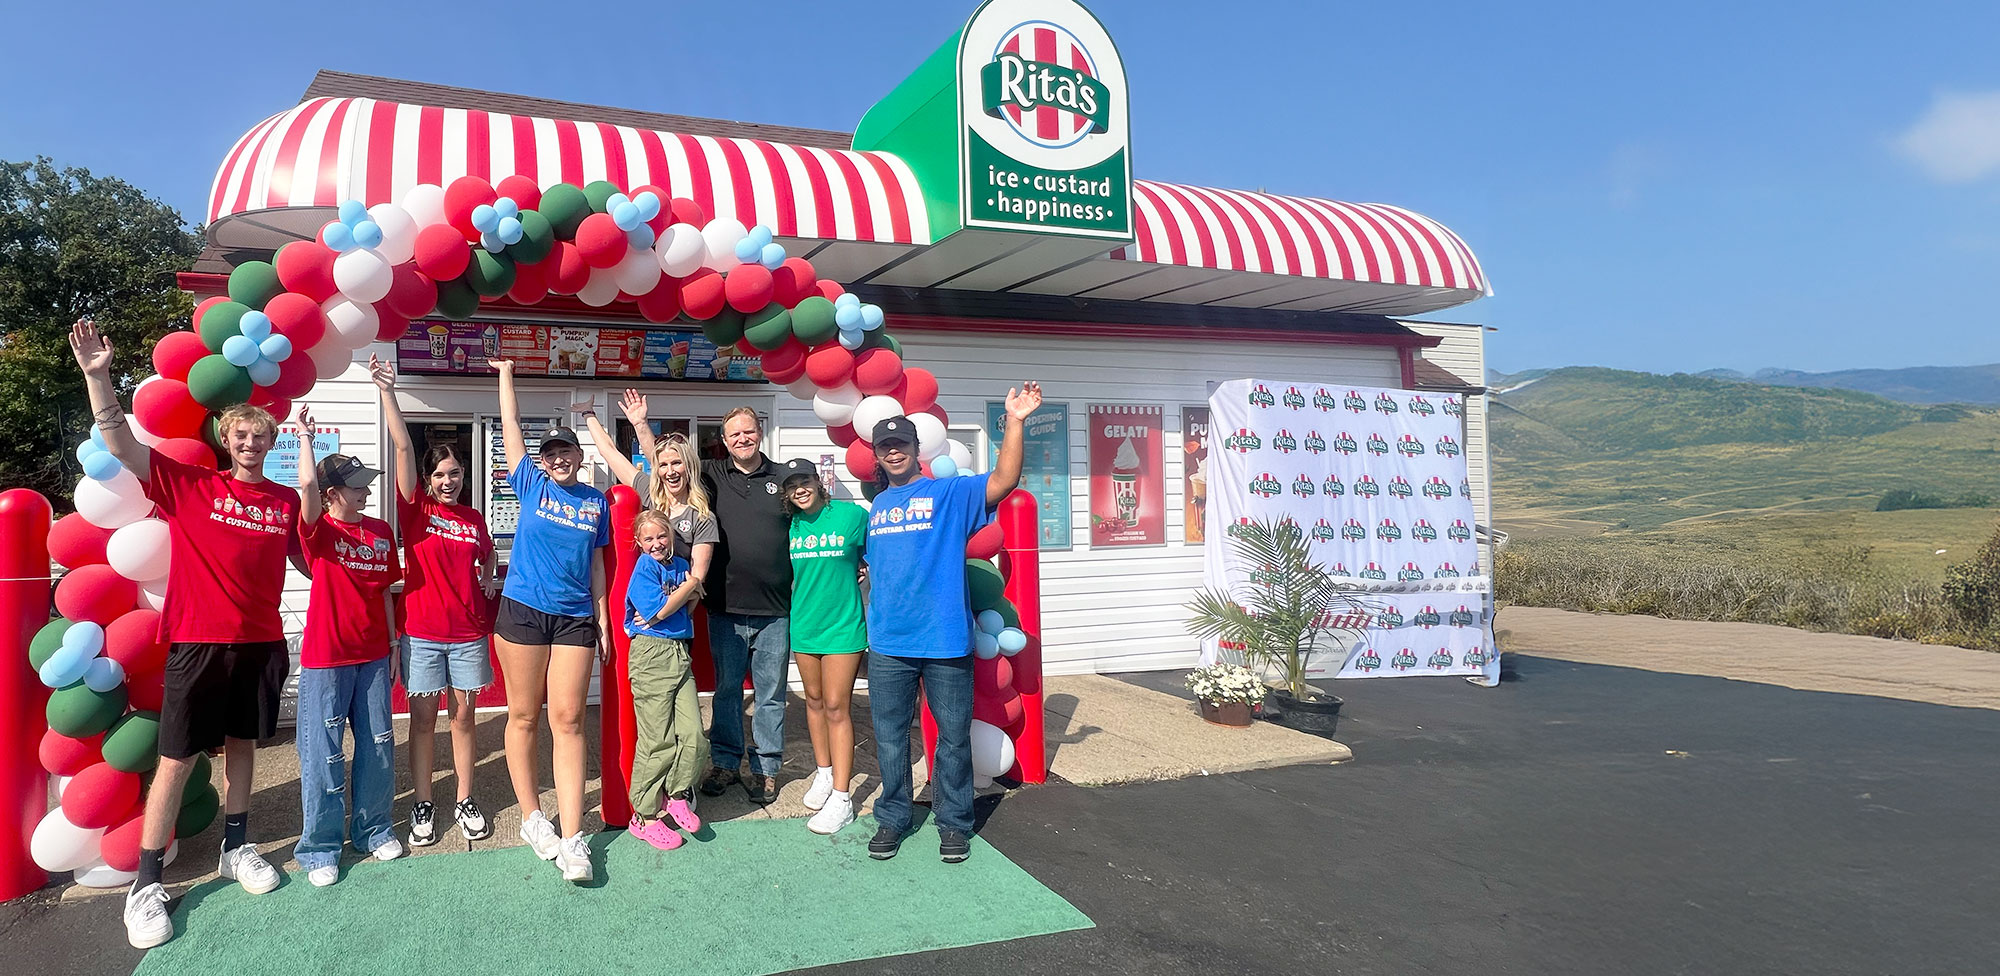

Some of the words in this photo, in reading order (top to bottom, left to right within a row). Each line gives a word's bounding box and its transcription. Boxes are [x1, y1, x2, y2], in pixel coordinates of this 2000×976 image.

[999, 55, 1098, 116] Rita's
[988, 164, 1019, 188] ice
[1033, 174, 1110, 198] custard
[997, 190, 1105, 222] happiness
[502, 328, 532, 336] CUSTARD
[560, 330, 590, 338] PUMPKIN
[1253, 391, 1273, 402] Rita's
[1285, 393, 1303, 404] Rita's
[1315, 395, 1334, 406] Rita's
[1346, 397, 1365, 409] Rita's
[1377, 399, 1397, 410] Rita's
[1411, 402, 1432, 413] Rita's
[1024, 412, 1063, 427] RDERING
[1029, 423, 1057, 437] GUIDE
[1103, 425, 1149, 438] GELATI
[287, 440, 296, 450] OF
[1230, 435, 1259, 447] Rita's
[1275, 437, 1295, 447] Rita's
[1306, 438, 1325, 449] Rita's
[1336, 439, 1356, 450] Rita's
[1368, 440, 1387, 450] Rita's
[1398, 441, 1423, 452] Rita's
[1439, 442, 1458, 452] Rita's
[1253, 480, 1280, 492] Rita's
[1294, 481, 1313, 492] Rita's
[1325, 481, 1344, 492] Rita's
[1357, 481, 1378, 492] Rita's
[1390, 482, 1411, 493] Rita's
[1426, 483, 1450, 494] Rita's
[225, 517, 264, 532] CUSTARD.
[546, 513, 577, 529] CUSTARD.
[905, 522, 933, 532] REPEAT.
[1314, 526, 1333, 536] Rita's
[1343, 525, 1364, 536] Rita's
[1379, 526, 1400, 537] Rita's
[1414, 526, 1435, 537] Rita's
[1450, 526, 1469, 537] Rita's
[819, 550, 845, 558] REPEAT.
[345, 560, 373, 571] USTARD.
[1401, 570, 1423, 581] Rita's
[1380, 612, 1402, 624] Rita's
[1417, 612, 1439, 623] Rita's
[1359, 655, 1380, 667] Rita's
[1394, 655, 1416, 666] Rita's
[1431, 654, 1452, 666] Rita's
[1465, 652, 1485, 665] Rita's
